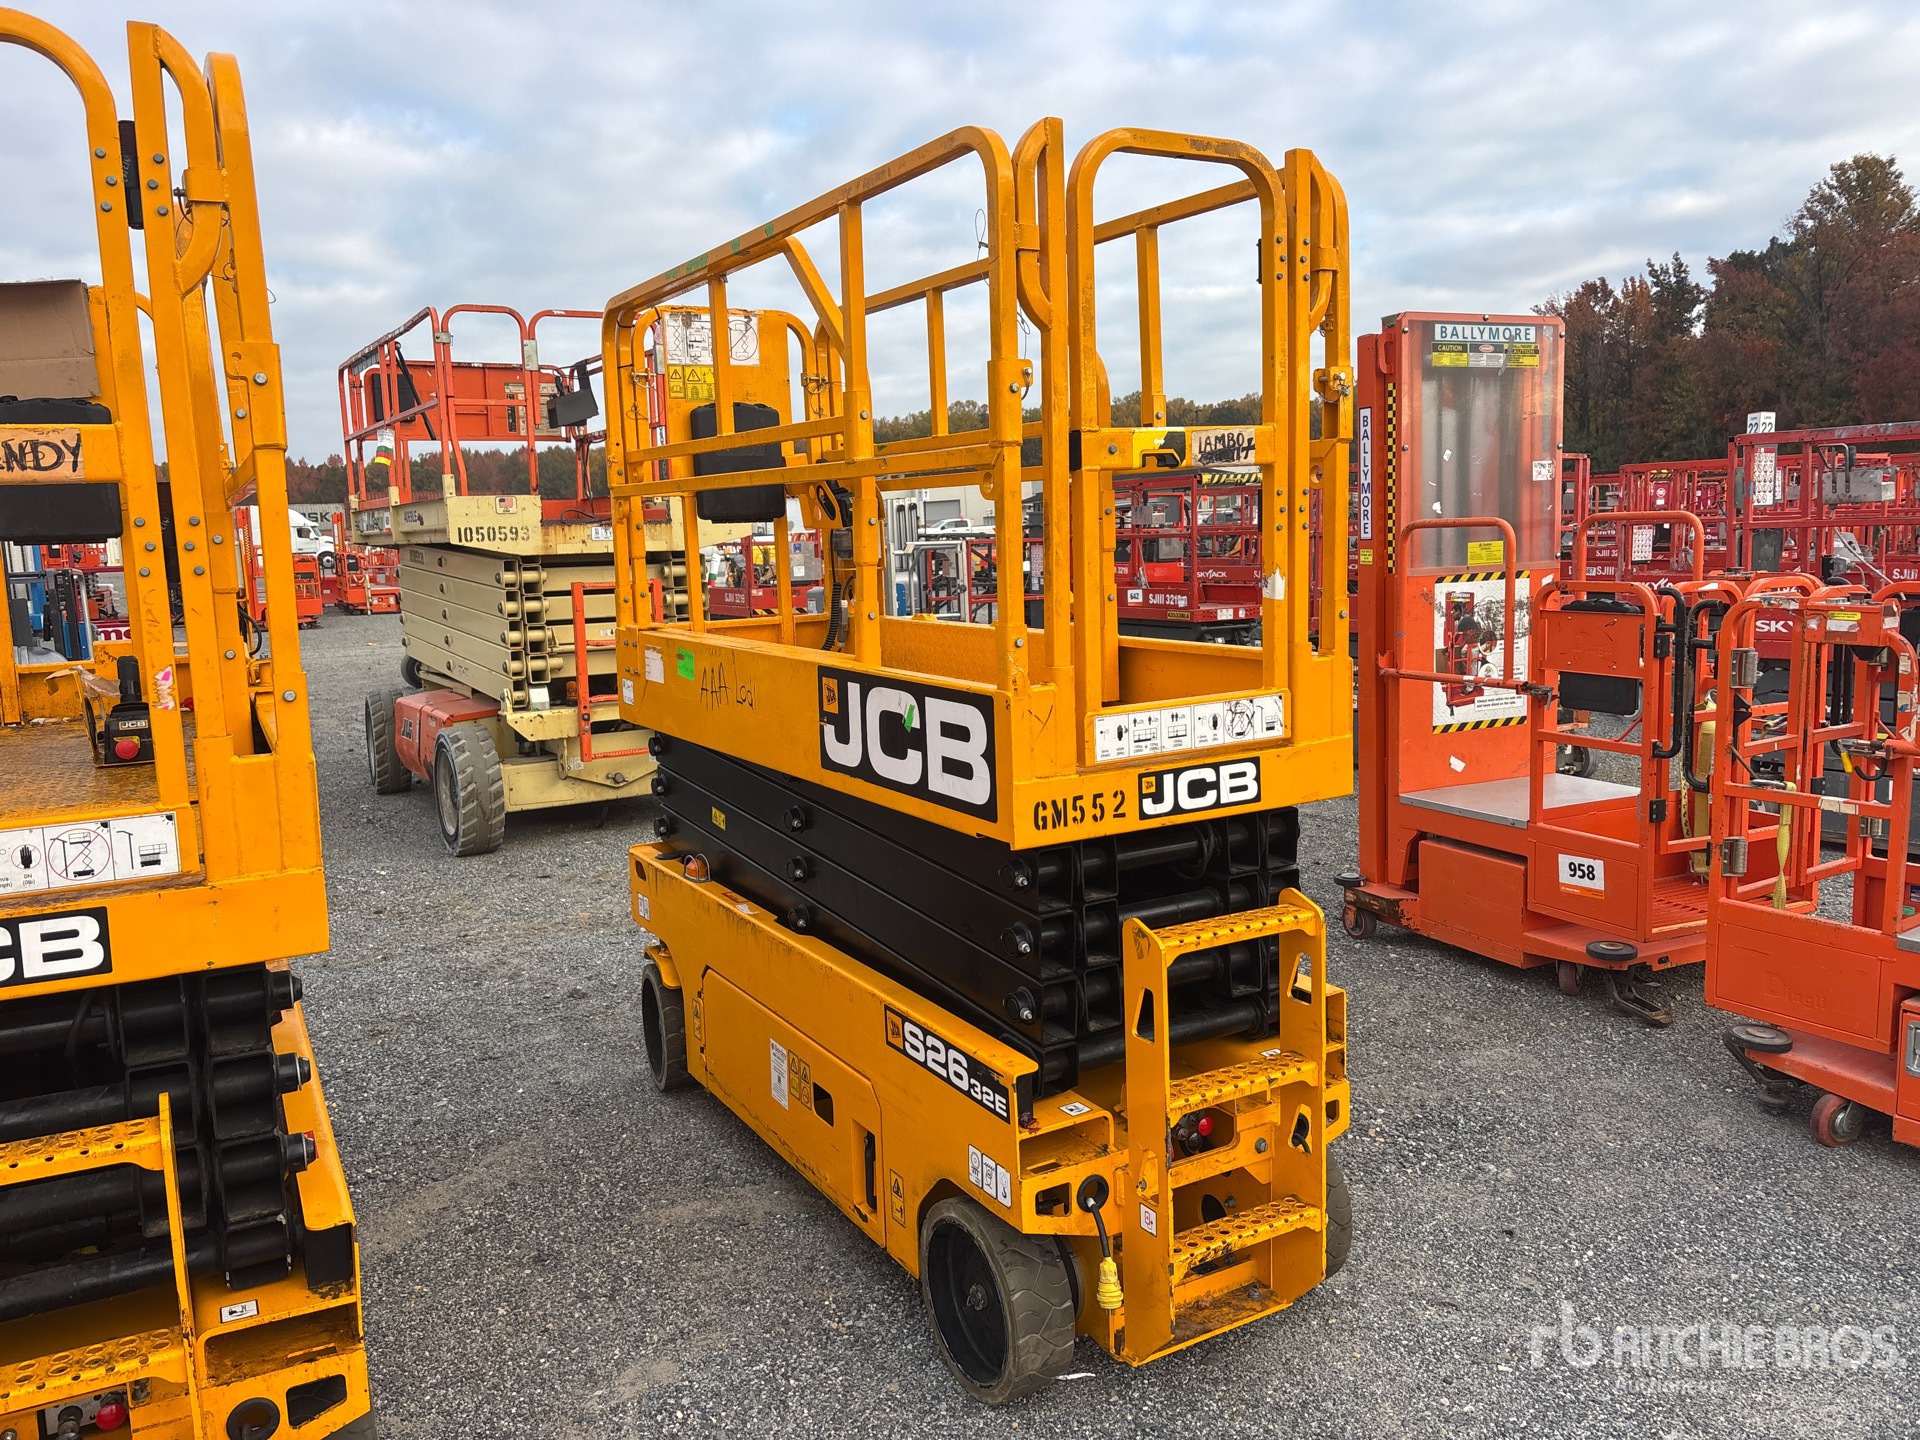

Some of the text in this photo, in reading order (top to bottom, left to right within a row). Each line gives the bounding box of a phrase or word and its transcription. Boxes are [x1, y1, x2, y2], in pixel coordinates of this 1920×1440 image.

[1440, 325, 1531, 341] BALLYMORE
[1198, 432, 1245, 454] LAMBO
[1361, 415, 1370, 534] BALLYMORE
[457, 526, 531, 544] 1050593
[1196, 568, 1227, 579] SKYJACK
[1129, 592, 1140, 600] 642
[121, 721, 146, 729] JCB
[824, 681, 992, 806] JCB
[1142, 761, 1259, 815] JCB
[1033, 789, 1127, 831] GM552
[1568, 861, 1596, 881] 958
